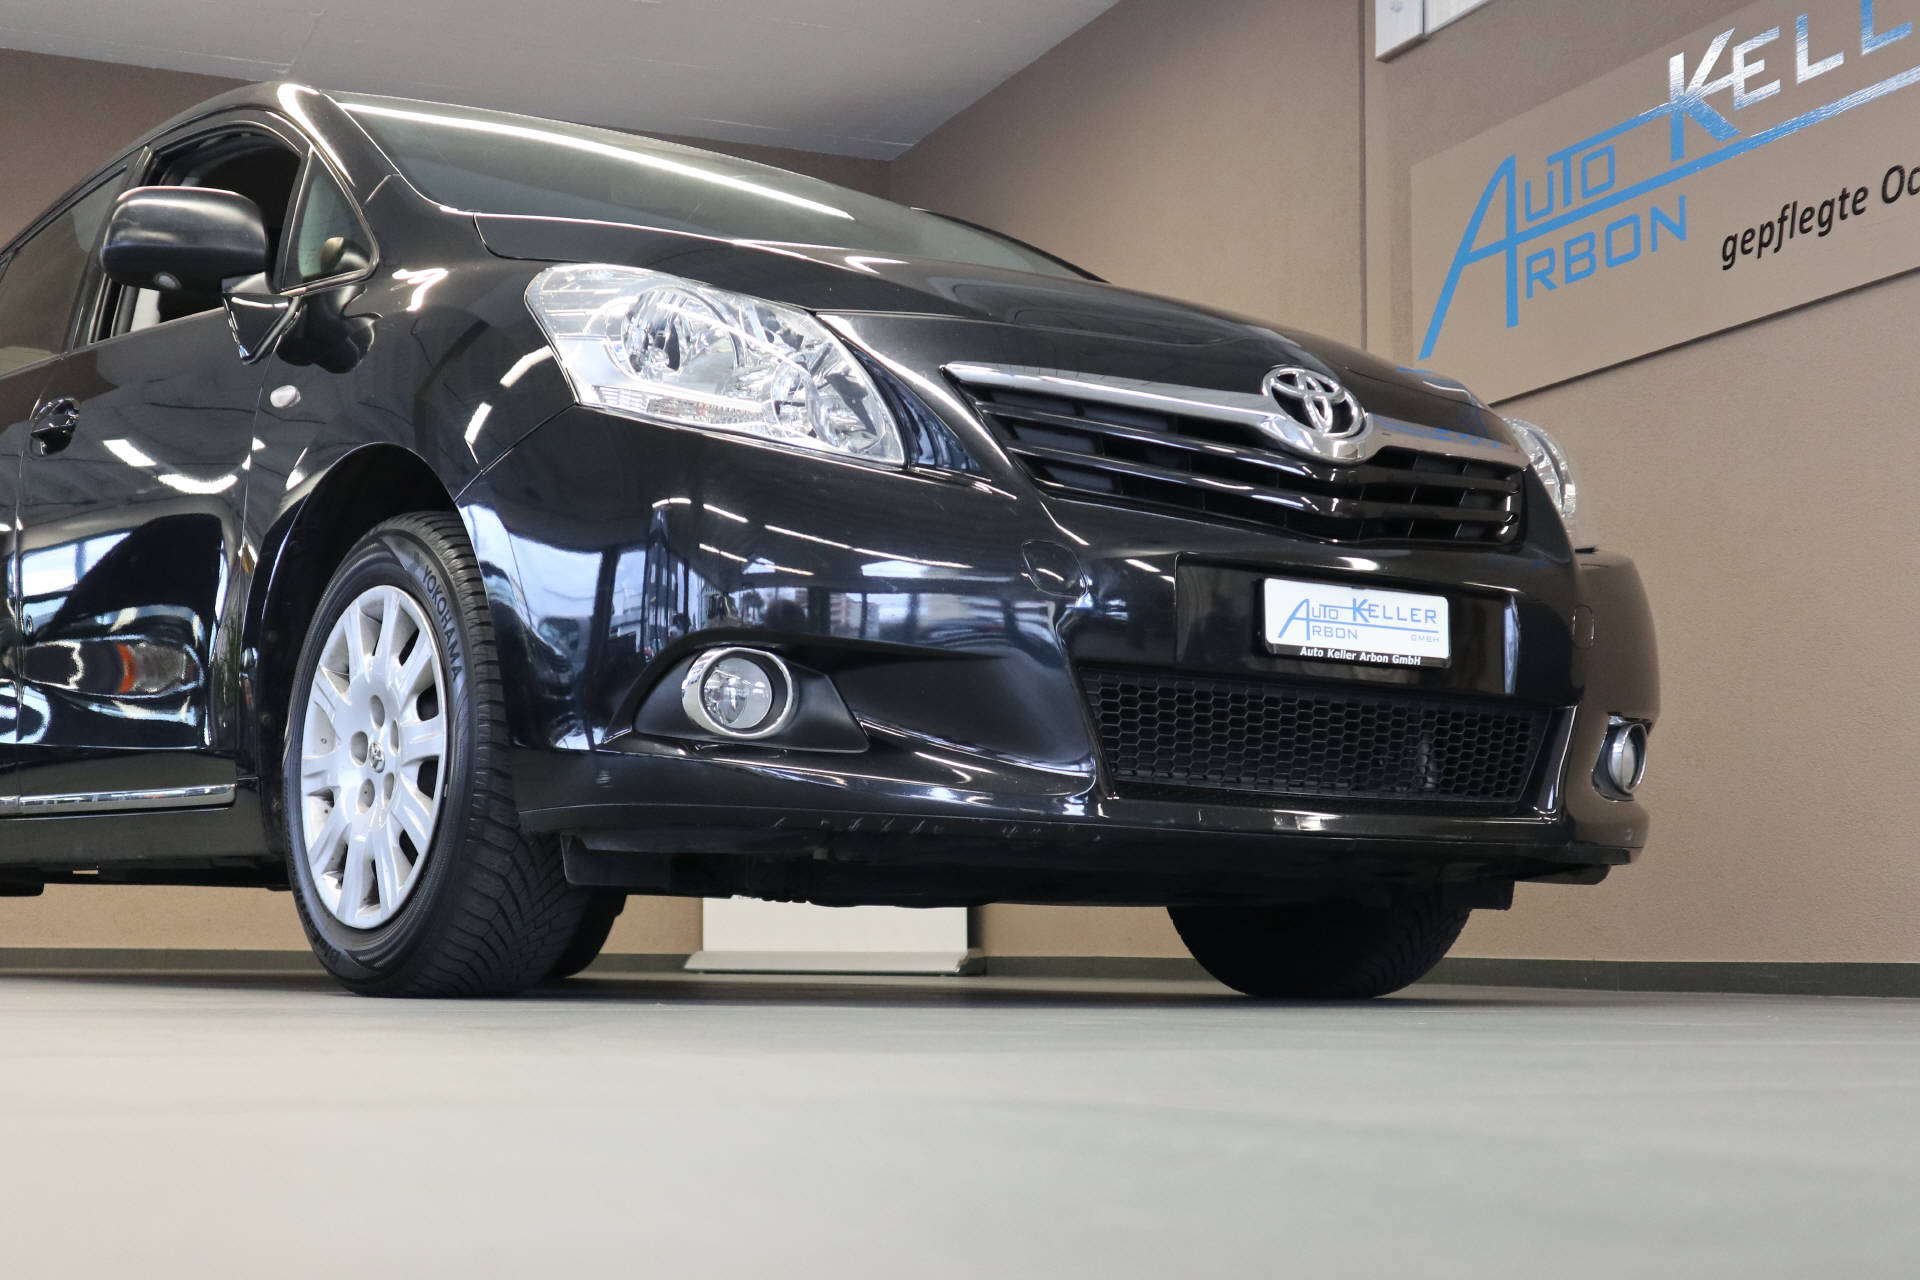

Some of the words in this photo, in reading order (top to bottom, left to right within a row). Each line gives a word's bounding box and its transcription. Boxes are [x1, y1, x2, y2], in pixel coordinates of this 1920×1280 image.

[1721, 185, 1869, 271] gepflegte
[422, 565, 463, 682] YOKOHAMA
[1352, 597, 1438, 625] KELLER
[1300, 645, 1324, 658] Auto
[1327, 648, 1357, 660] Keller
[1359, 651, 1389, 664] Arbon
[1392, 654, 1422, 666] GmbH
